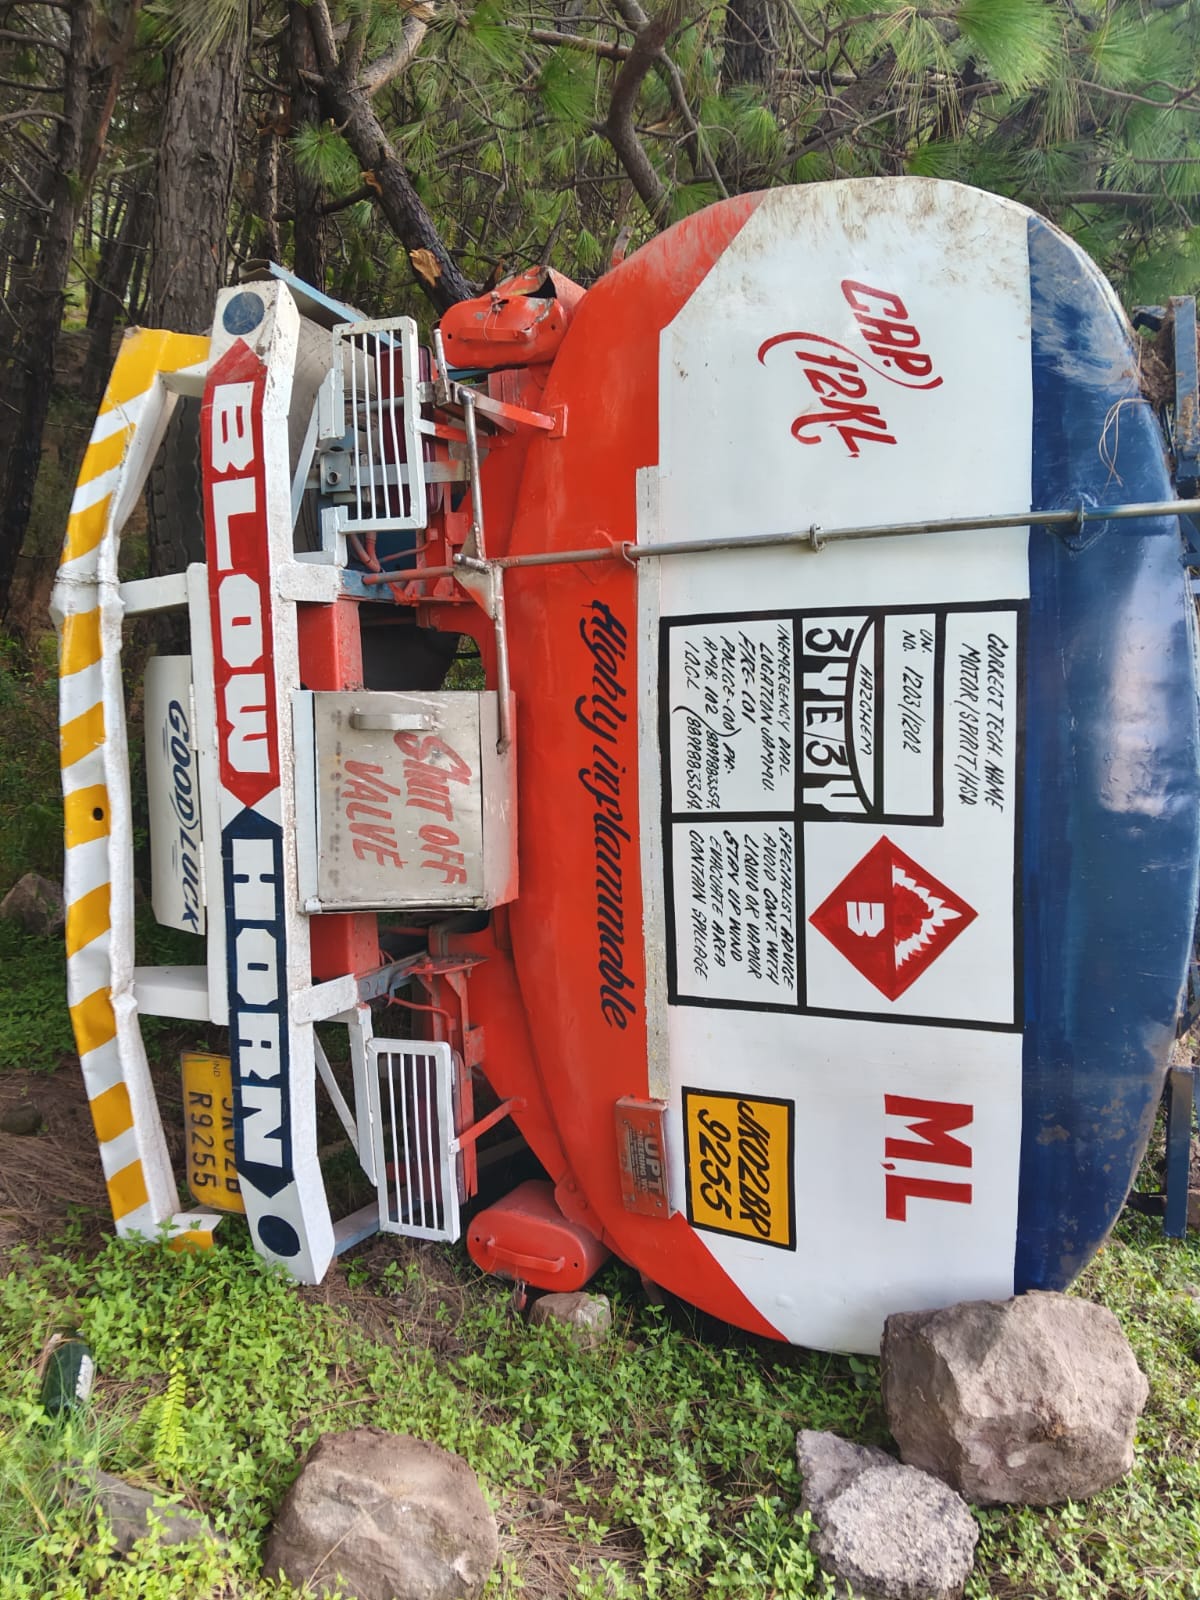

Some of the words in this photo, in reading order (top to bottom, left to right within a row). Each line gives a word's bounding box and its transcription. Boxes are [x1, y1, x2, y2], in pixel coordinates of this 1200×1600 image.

[211, 380, 271, 773] BLOW
[575, 600, 627, 744] Highly
[703, 636, 718, 679] AMB.
[902, 630, 916, 652] NO.
[920, 628, 933, 653] UN.
[987, 633, 1009, 711] CORRECT
[705, 686, 718, 715] 102
[759, 642, 774, 725] LOCATION
[858, 664, 873, 755] HAZCHEM
[898, 666, 926, 754] 1203/1202
[169, 700, 194, 821] GOOD
[760, 727, 775, 791] JAMMU.
[778, 737, 791, 776] DIAL
[986, 712, 1004, 755] TECH.
[341, 760, 403, 869] VALVE
[984, 760, 1004, 813] NAME
[180, 828, 199, 932] LUCK
[418, 825, 467, 885] OFF
[689, 830, 706, 905] CONTAIN
[709, 835, 724, 918] EVACUATE
[723, 830, 740, 886] STAY
[743, 834, 759, 892] LIQUID
[762, 832, 777, 881] AVOID
[778, 827, 792, 928] SPECIALIST
[578, 745, 636, 1030] inflammable
[728, 888, 741, 916] UP
[744, 895, 760, 919] OR
[763, 888, 778, 938] CONT.
[691, 908, 708, 982] SPILLAGE
[711, 920, 726, 968] AREA
[729, 917, 743, 962] WIND
[746, 922, 762, 980] VAPOUR
[765, 940, 780, 986] WITH
[780, 925, 794, 991] ADVICE
[232, 838, 283, 1168] HORN
[189, 1091, 216, 1187] R9255
[644, 1137, 662, 1196] UPT
[697, 1109, 731, 1220] 9255
[737, 1100, 771, 1238] JK02BR
